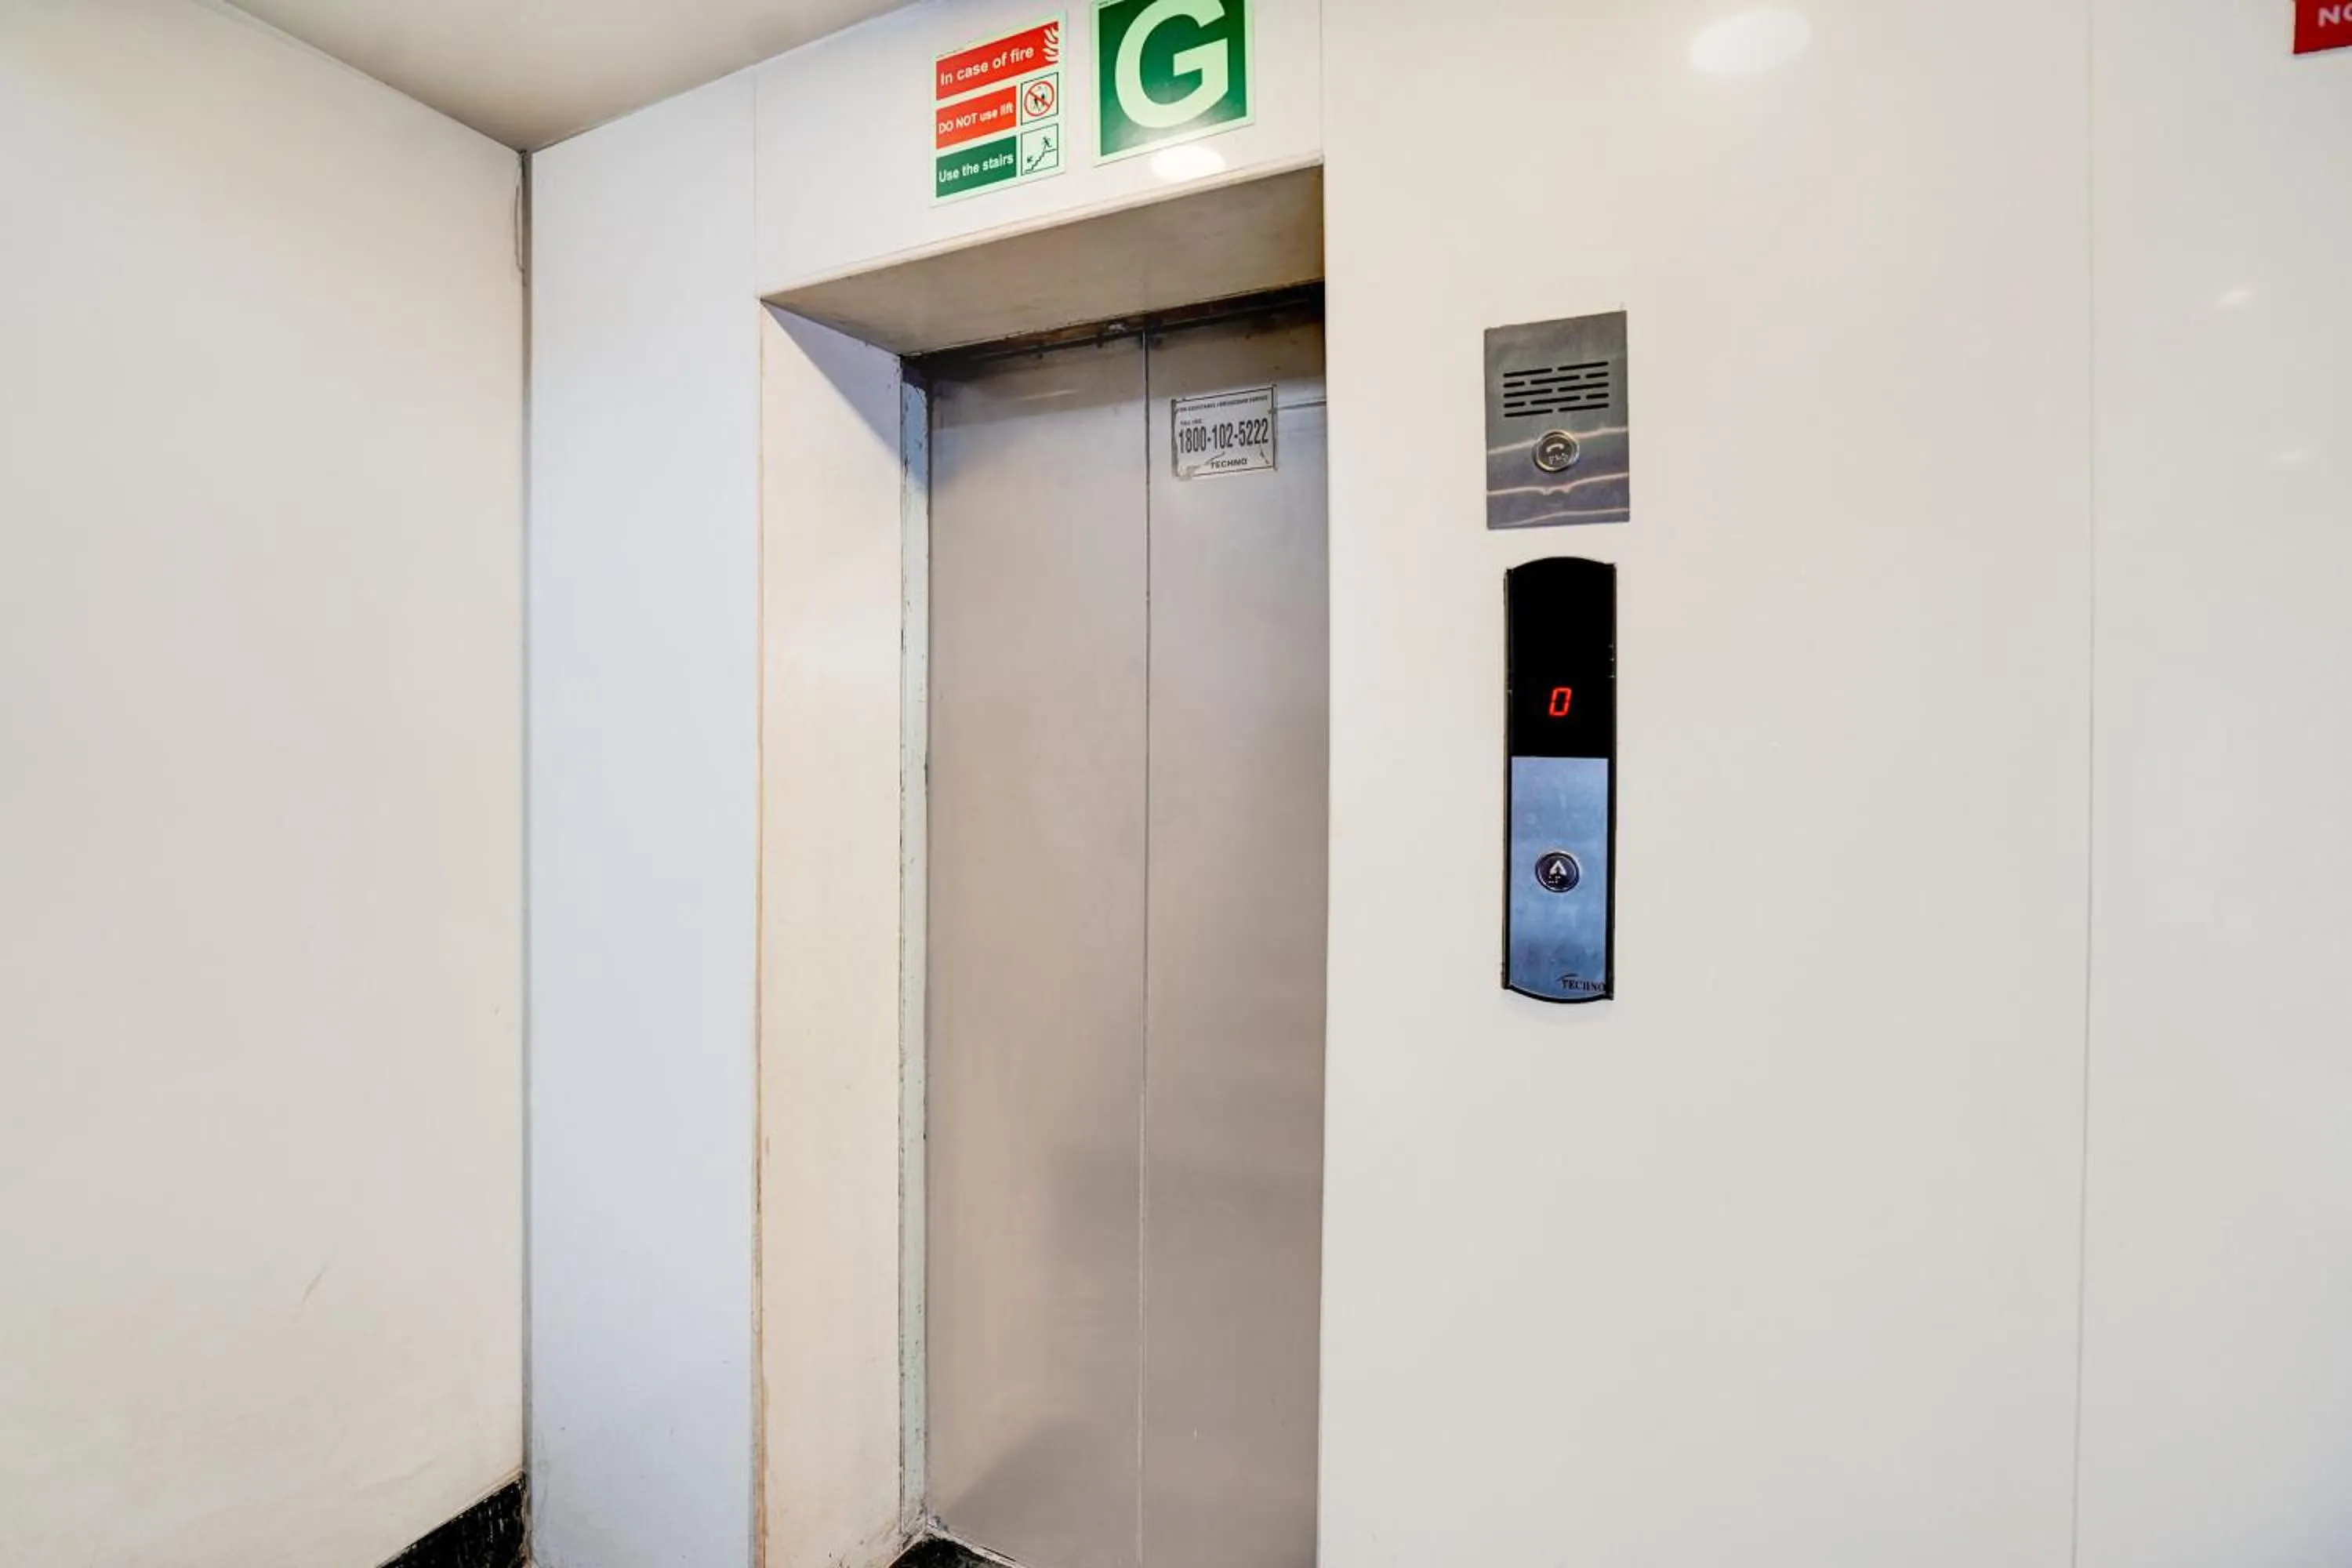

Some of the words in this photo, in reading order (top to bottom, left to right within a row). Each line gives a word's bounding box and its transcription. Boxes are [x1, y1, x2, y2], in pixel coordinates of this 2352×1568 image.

[941, 73, 953, 85] In
[957, 62, 989, 80] case
[993, 52, 1007, 69] of
[1010, 47, 1034, 63] fire
[1115, 0, 1229, 128] G
[938, 120, 953, 134] DO
[956, 113, 978, 129] NOT
[979, 109, 998, 122] use
[1000, 102, 1014, 116] lift
[938, 169, 960, 183] Use
[962, 163, 979, 176] the
[982, 154, 1014, 170] stairs
[1179, 418, 1269, 453] 1800-102-5222
[1210, 458, 1247, 469] TECHNO
